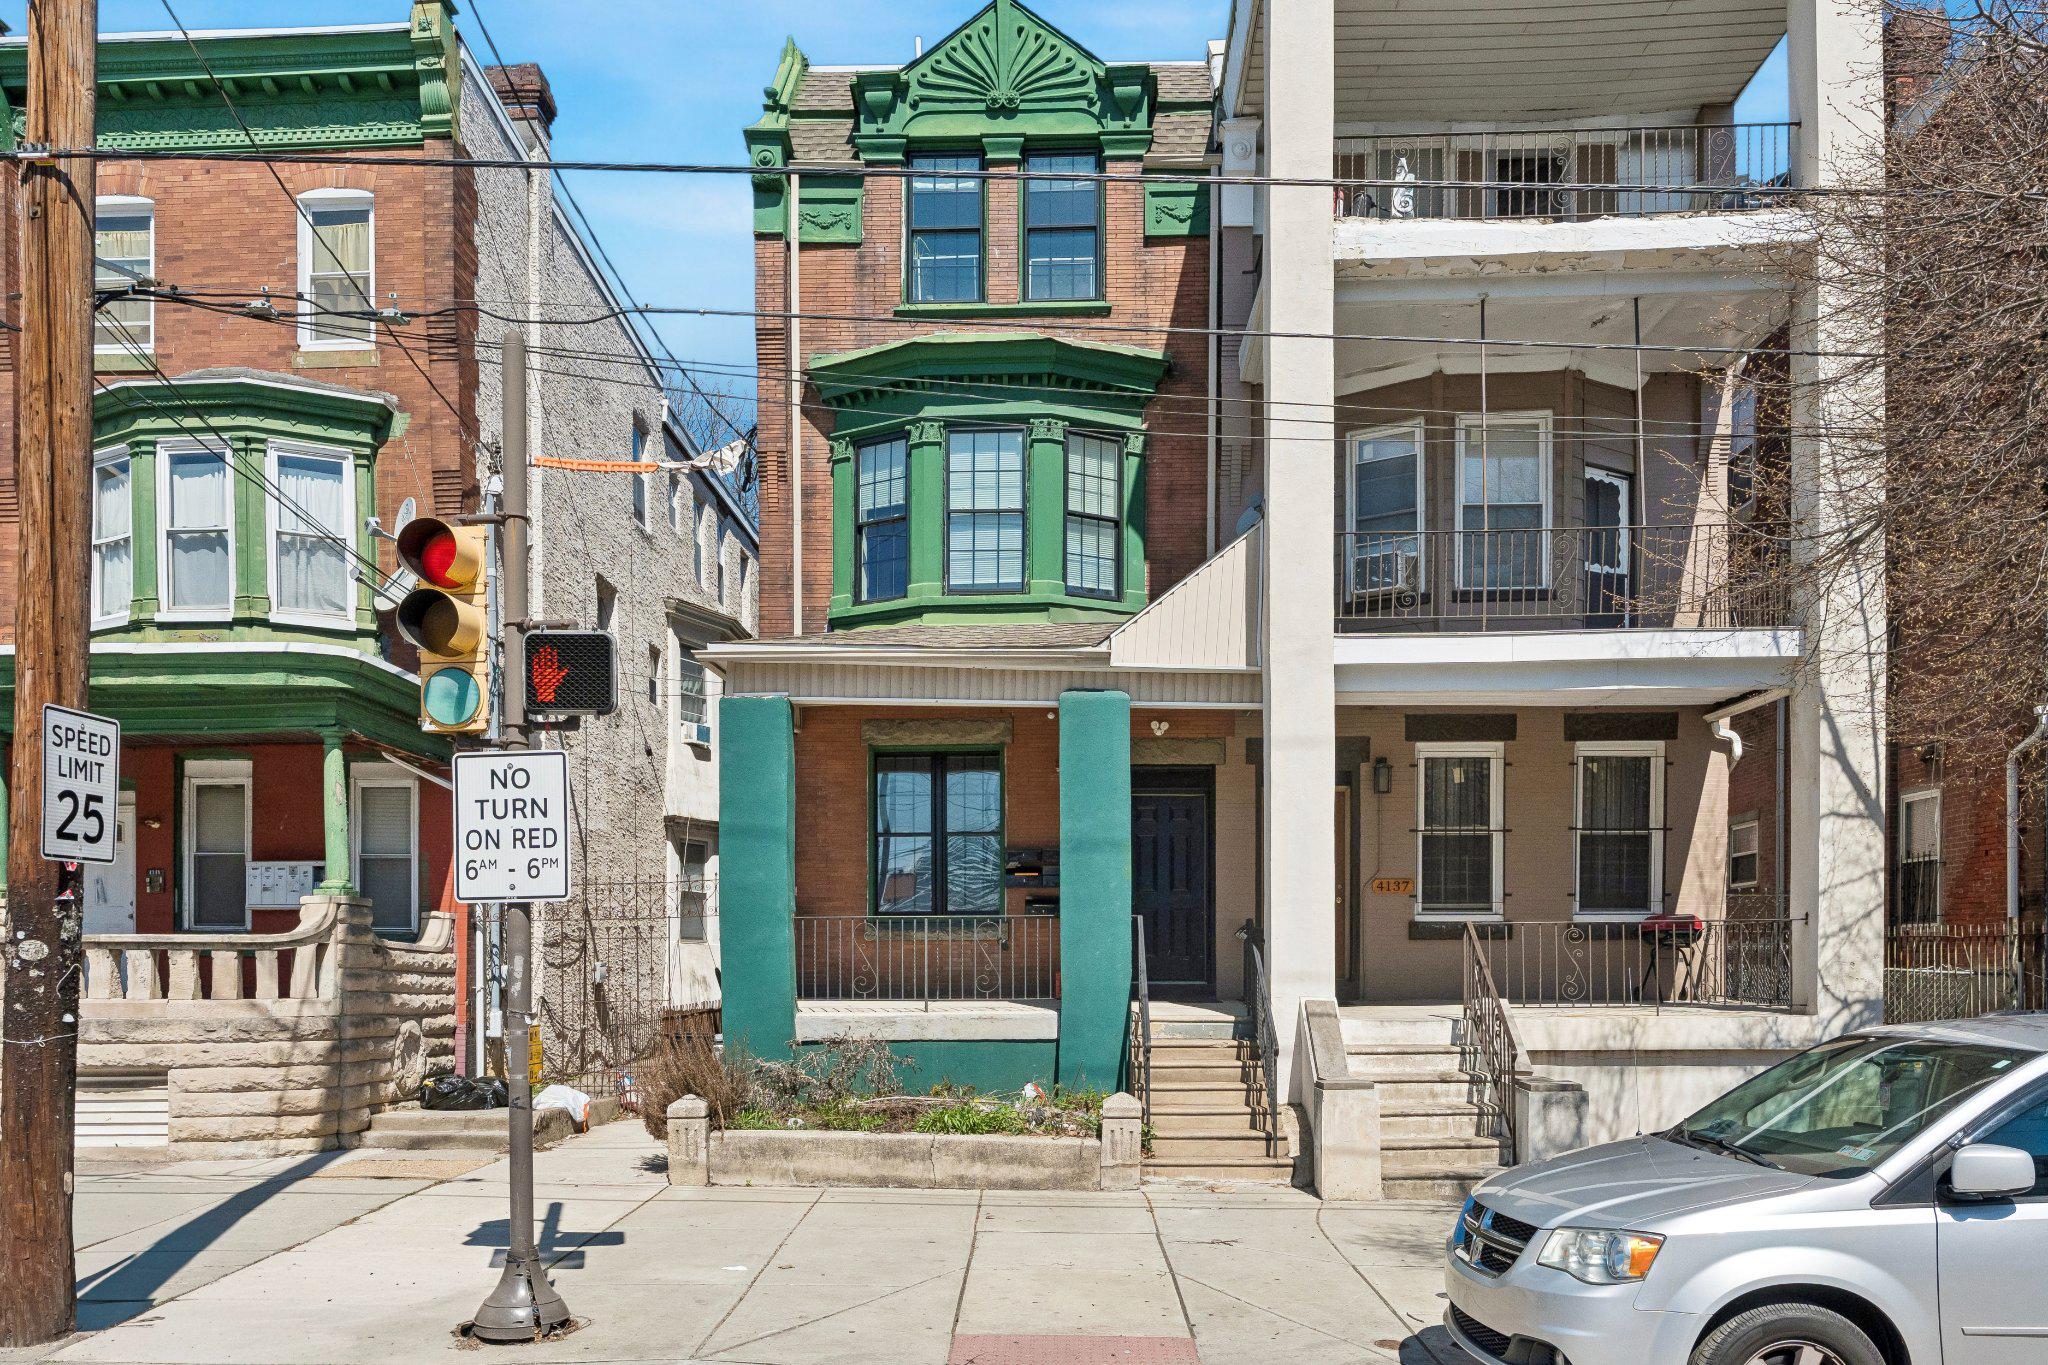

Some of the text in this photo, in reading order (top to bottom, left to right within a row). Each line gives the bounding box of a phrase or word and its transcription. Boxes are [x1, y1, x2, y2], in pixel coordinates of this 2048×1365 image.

[52, 724, 111, 757] SPEED
[58, 754, 104, 784] LIMIT
[490, 767, 531, 790] NO
[56, 789, 104, 844] 25
[474, 797, 548, 820] TURN
[465, 827, 558, 850] ON RED
[1376, 881, 1410, 892] 4137
